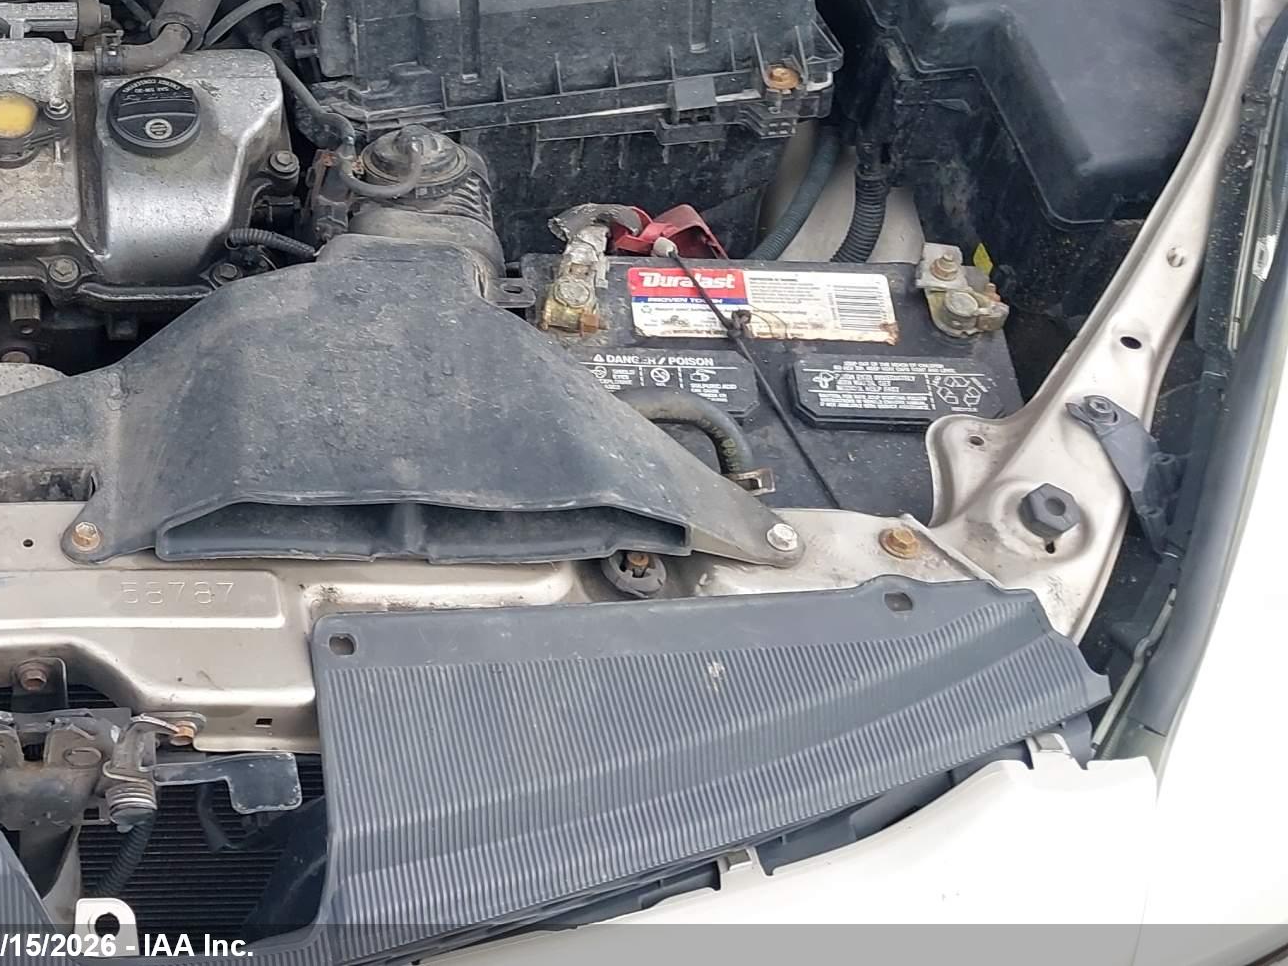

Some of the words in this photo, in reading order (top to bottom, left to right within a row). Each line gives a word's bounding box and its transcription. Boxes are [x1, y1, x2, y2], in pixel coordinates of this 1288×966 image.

[638, 271, 736, 289] Duralast
[668, 356, 714, 366] POISON
[120, 581, 234, 604] 58787
